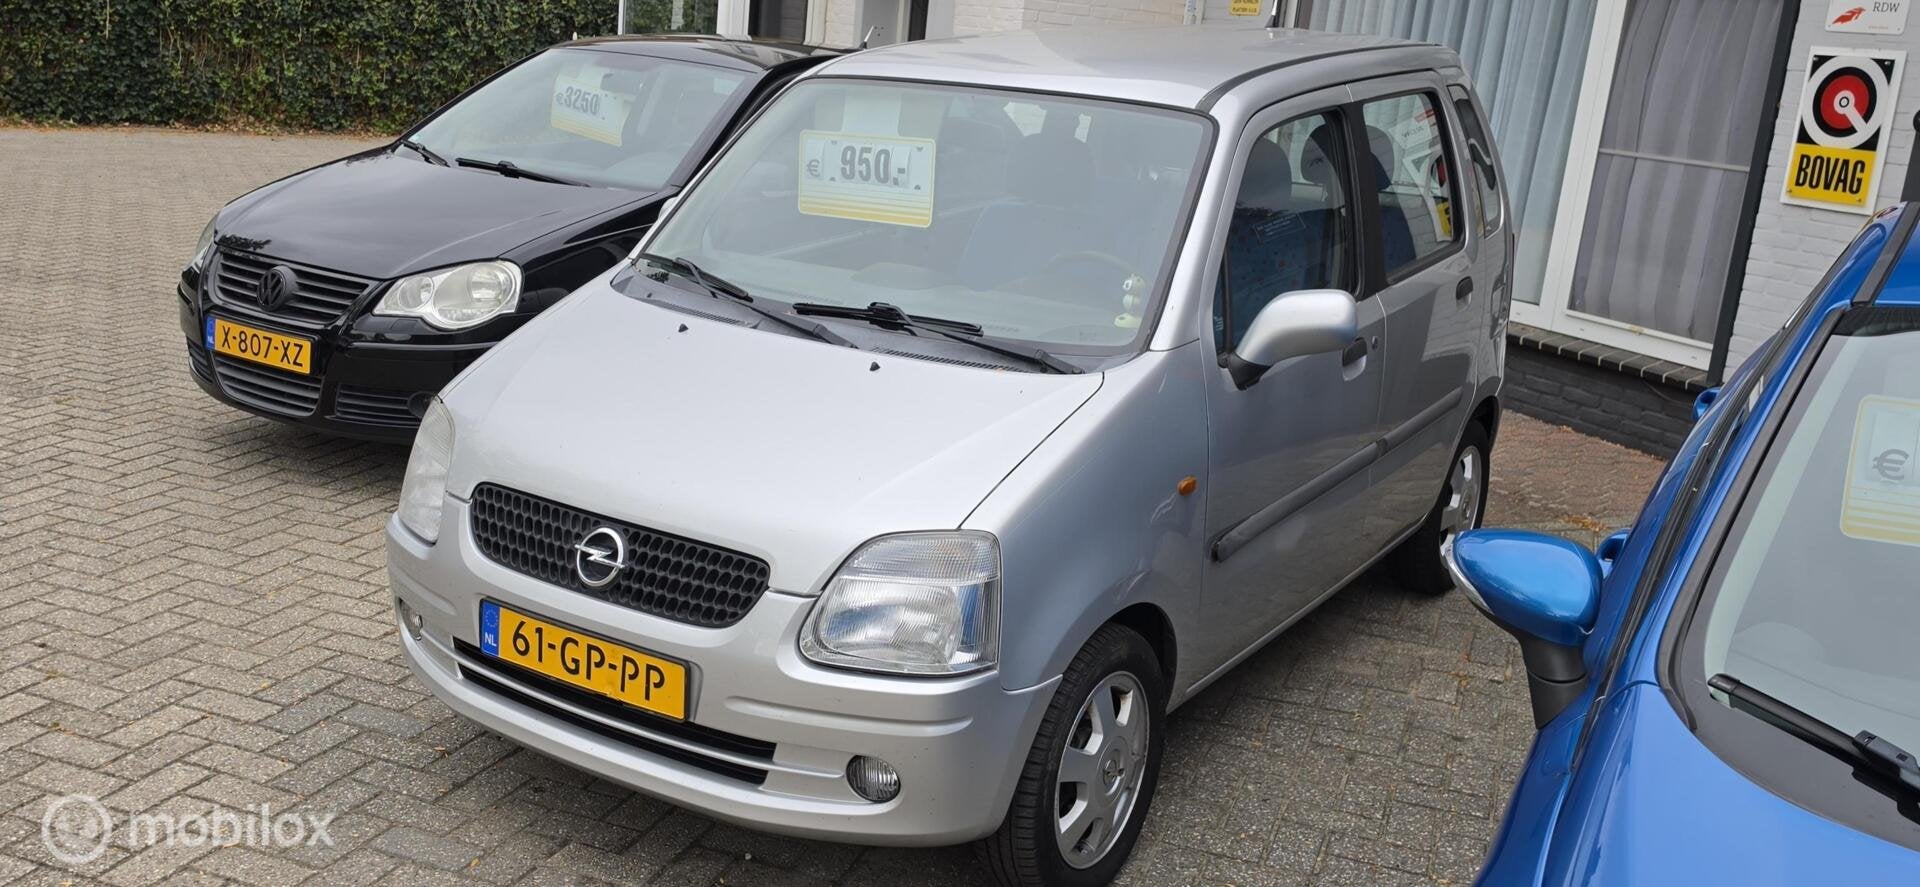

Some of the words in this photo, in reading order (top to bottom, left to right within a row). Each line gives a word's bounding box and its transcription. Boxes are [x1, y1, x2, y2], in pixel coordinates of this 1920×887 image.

[1872, 1, 1900, 13] RDW
[1795, 154, 1866, 195] BOVAG
[222, 325, 304, 368] X-807-XZ
[484, 633, 498, 647] NL
[512, 620, 665, 701] 61-GP-PP
